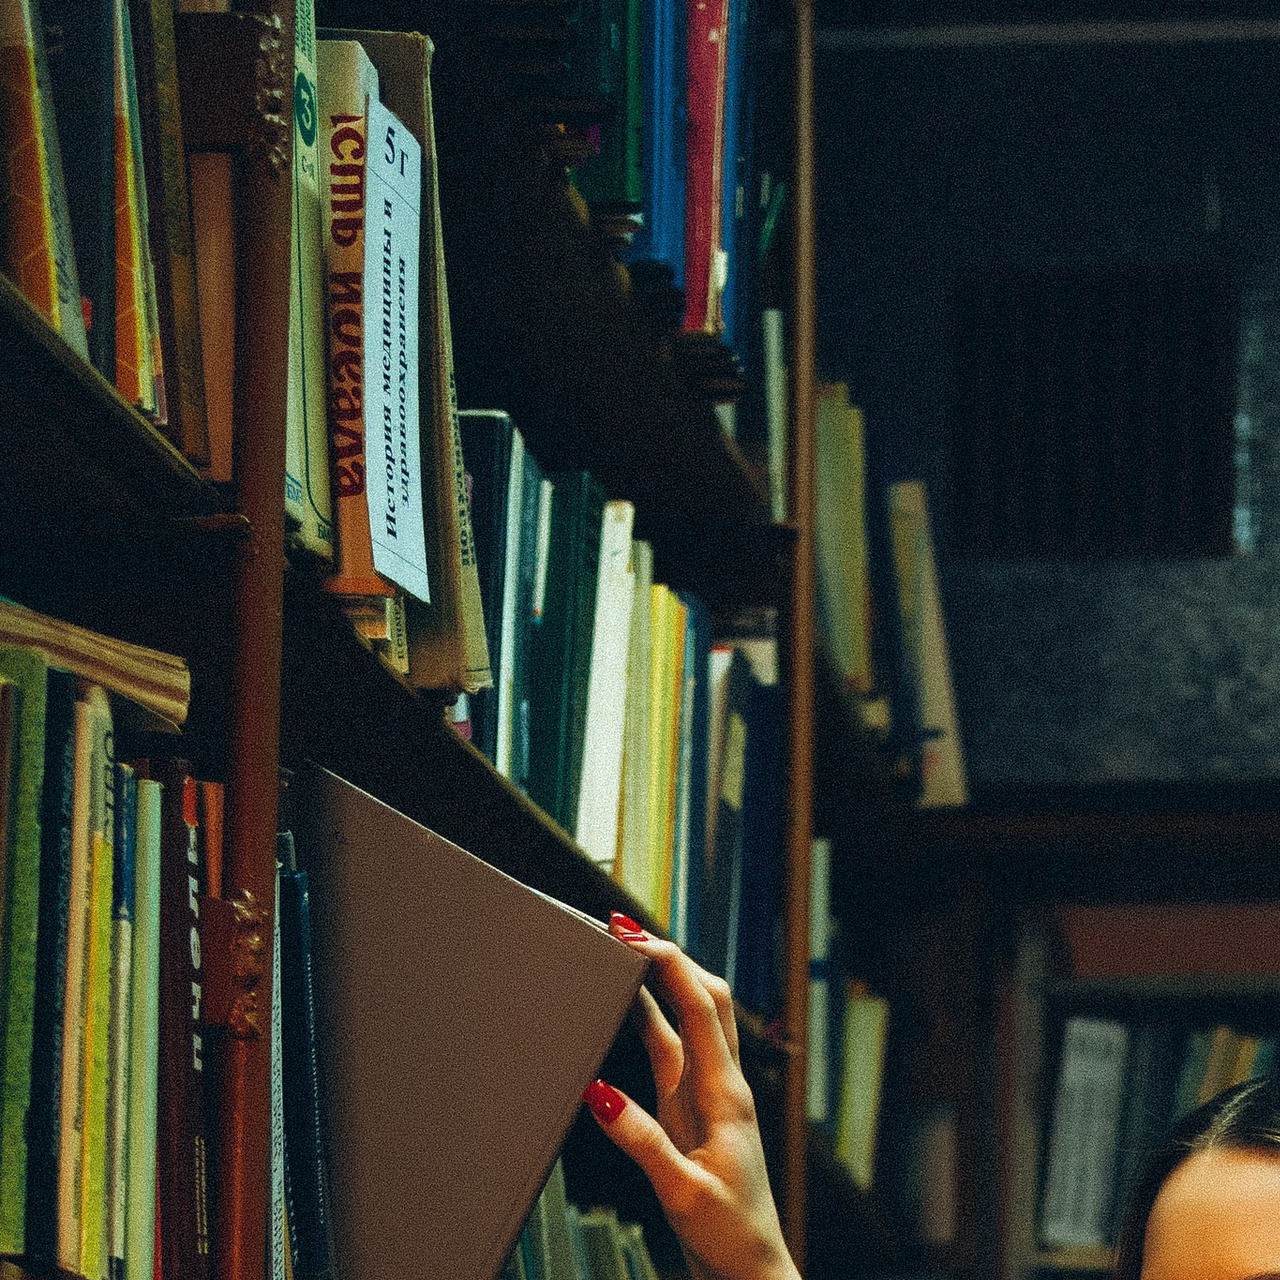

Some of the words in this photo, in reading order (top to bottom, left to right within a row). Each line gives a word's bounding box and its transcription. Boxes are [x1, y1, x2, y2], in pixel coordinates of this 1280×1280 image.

[383, 198, 392, 219] и
[380, 229, 392, 396] медицины
[382, 406, 397, 541] История
